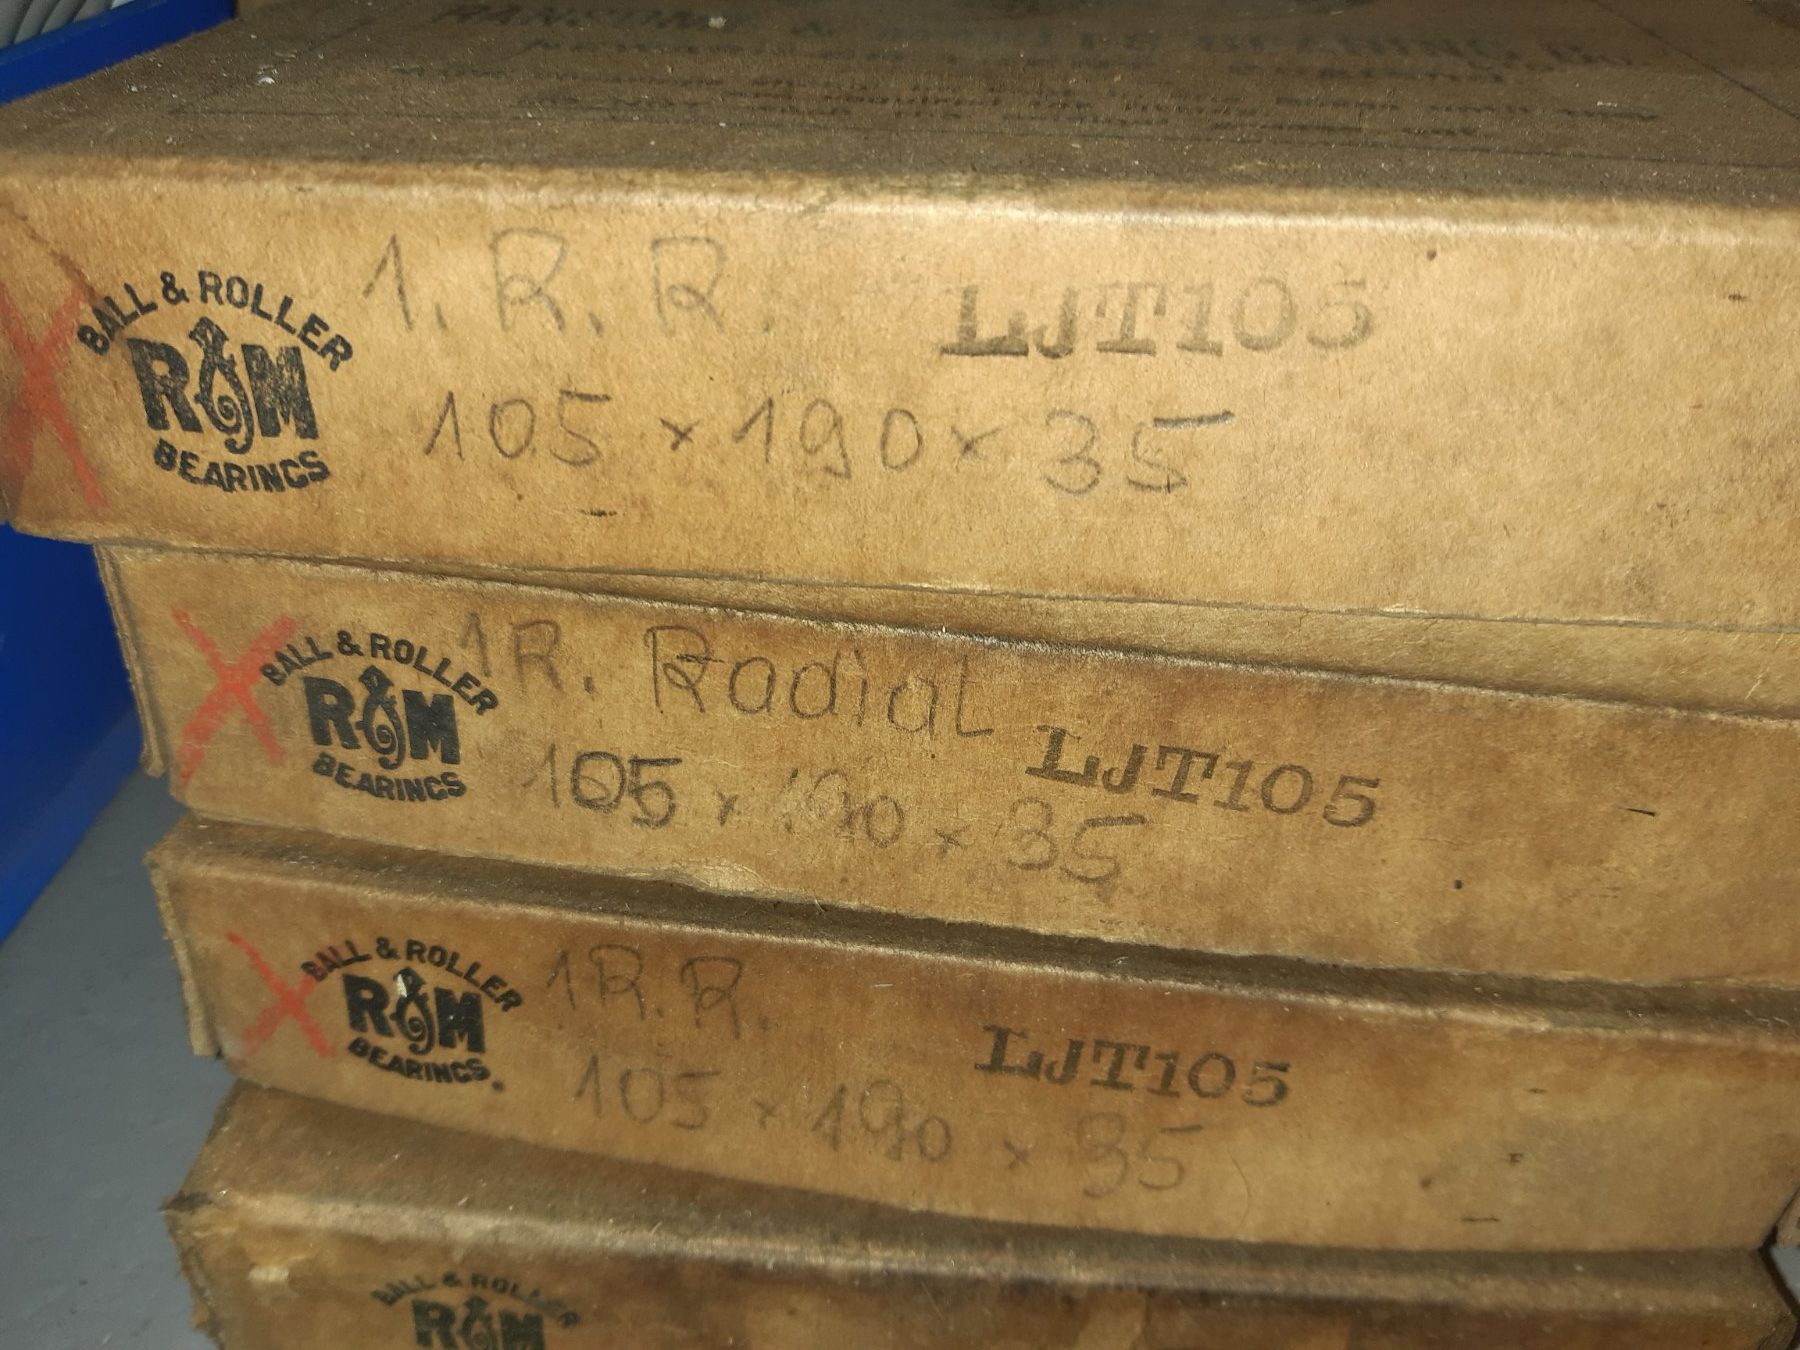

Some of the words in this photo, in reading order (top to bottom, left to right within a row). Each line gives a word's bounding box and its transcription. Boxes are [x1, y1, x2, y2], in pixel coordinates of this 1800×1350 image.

[76, 282, 157, 356] BALL
[161, 271, 189, 304] &
[198, 270, 353, 372] ROLLER
[940, 277, 1376, 360] LJT105
[153, 439, 331, 493] BEARINGS
[425, 389, 612, 467] 105
[731, 396, 925, 479] 190
[1043, 409, 1235, 494] 35
[259, 635, 334, 687] BALL
[337, 629, 364, 659] &
[369, 632, 500, 716] ROLLER
[311, 752, 467, 802] BEARINGS
[1025, 723, 1382, 829] LJT105
[1007, 799, 1148, 886] 35
[301, 940, 371, 983] BALL
[375, 937, 401, 959] &
[406, 939, 524, 1013] ROLLER
[347, 1036, 490, 1084] BEARINGS
[974, 1024, 1291, 1107] LJT105
[575, 1055, 721, 1130] 105
[1075, 1110, 1204, 1199] 35
